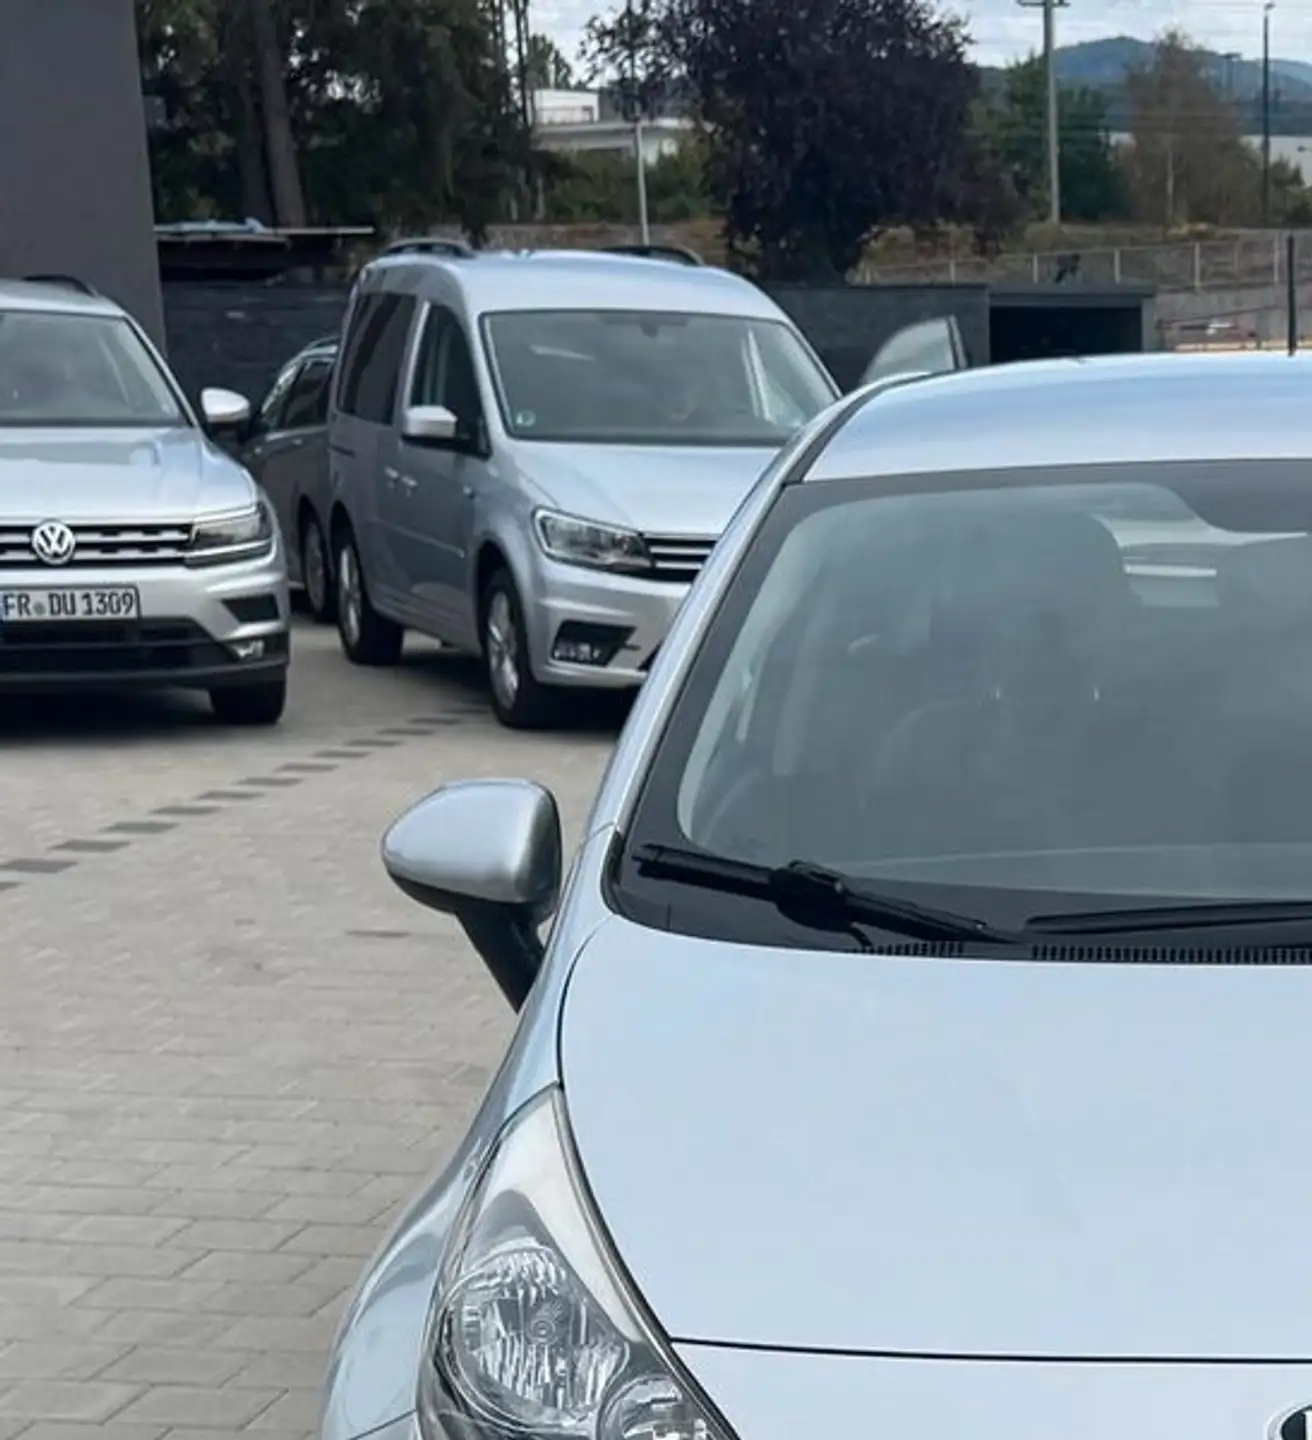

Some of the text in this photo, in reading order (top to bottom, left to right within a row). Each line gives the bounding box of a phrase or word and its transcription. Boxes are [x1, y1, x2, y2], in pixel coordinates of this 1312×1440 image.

[3, 590, 134, 617] FR DU 1309
